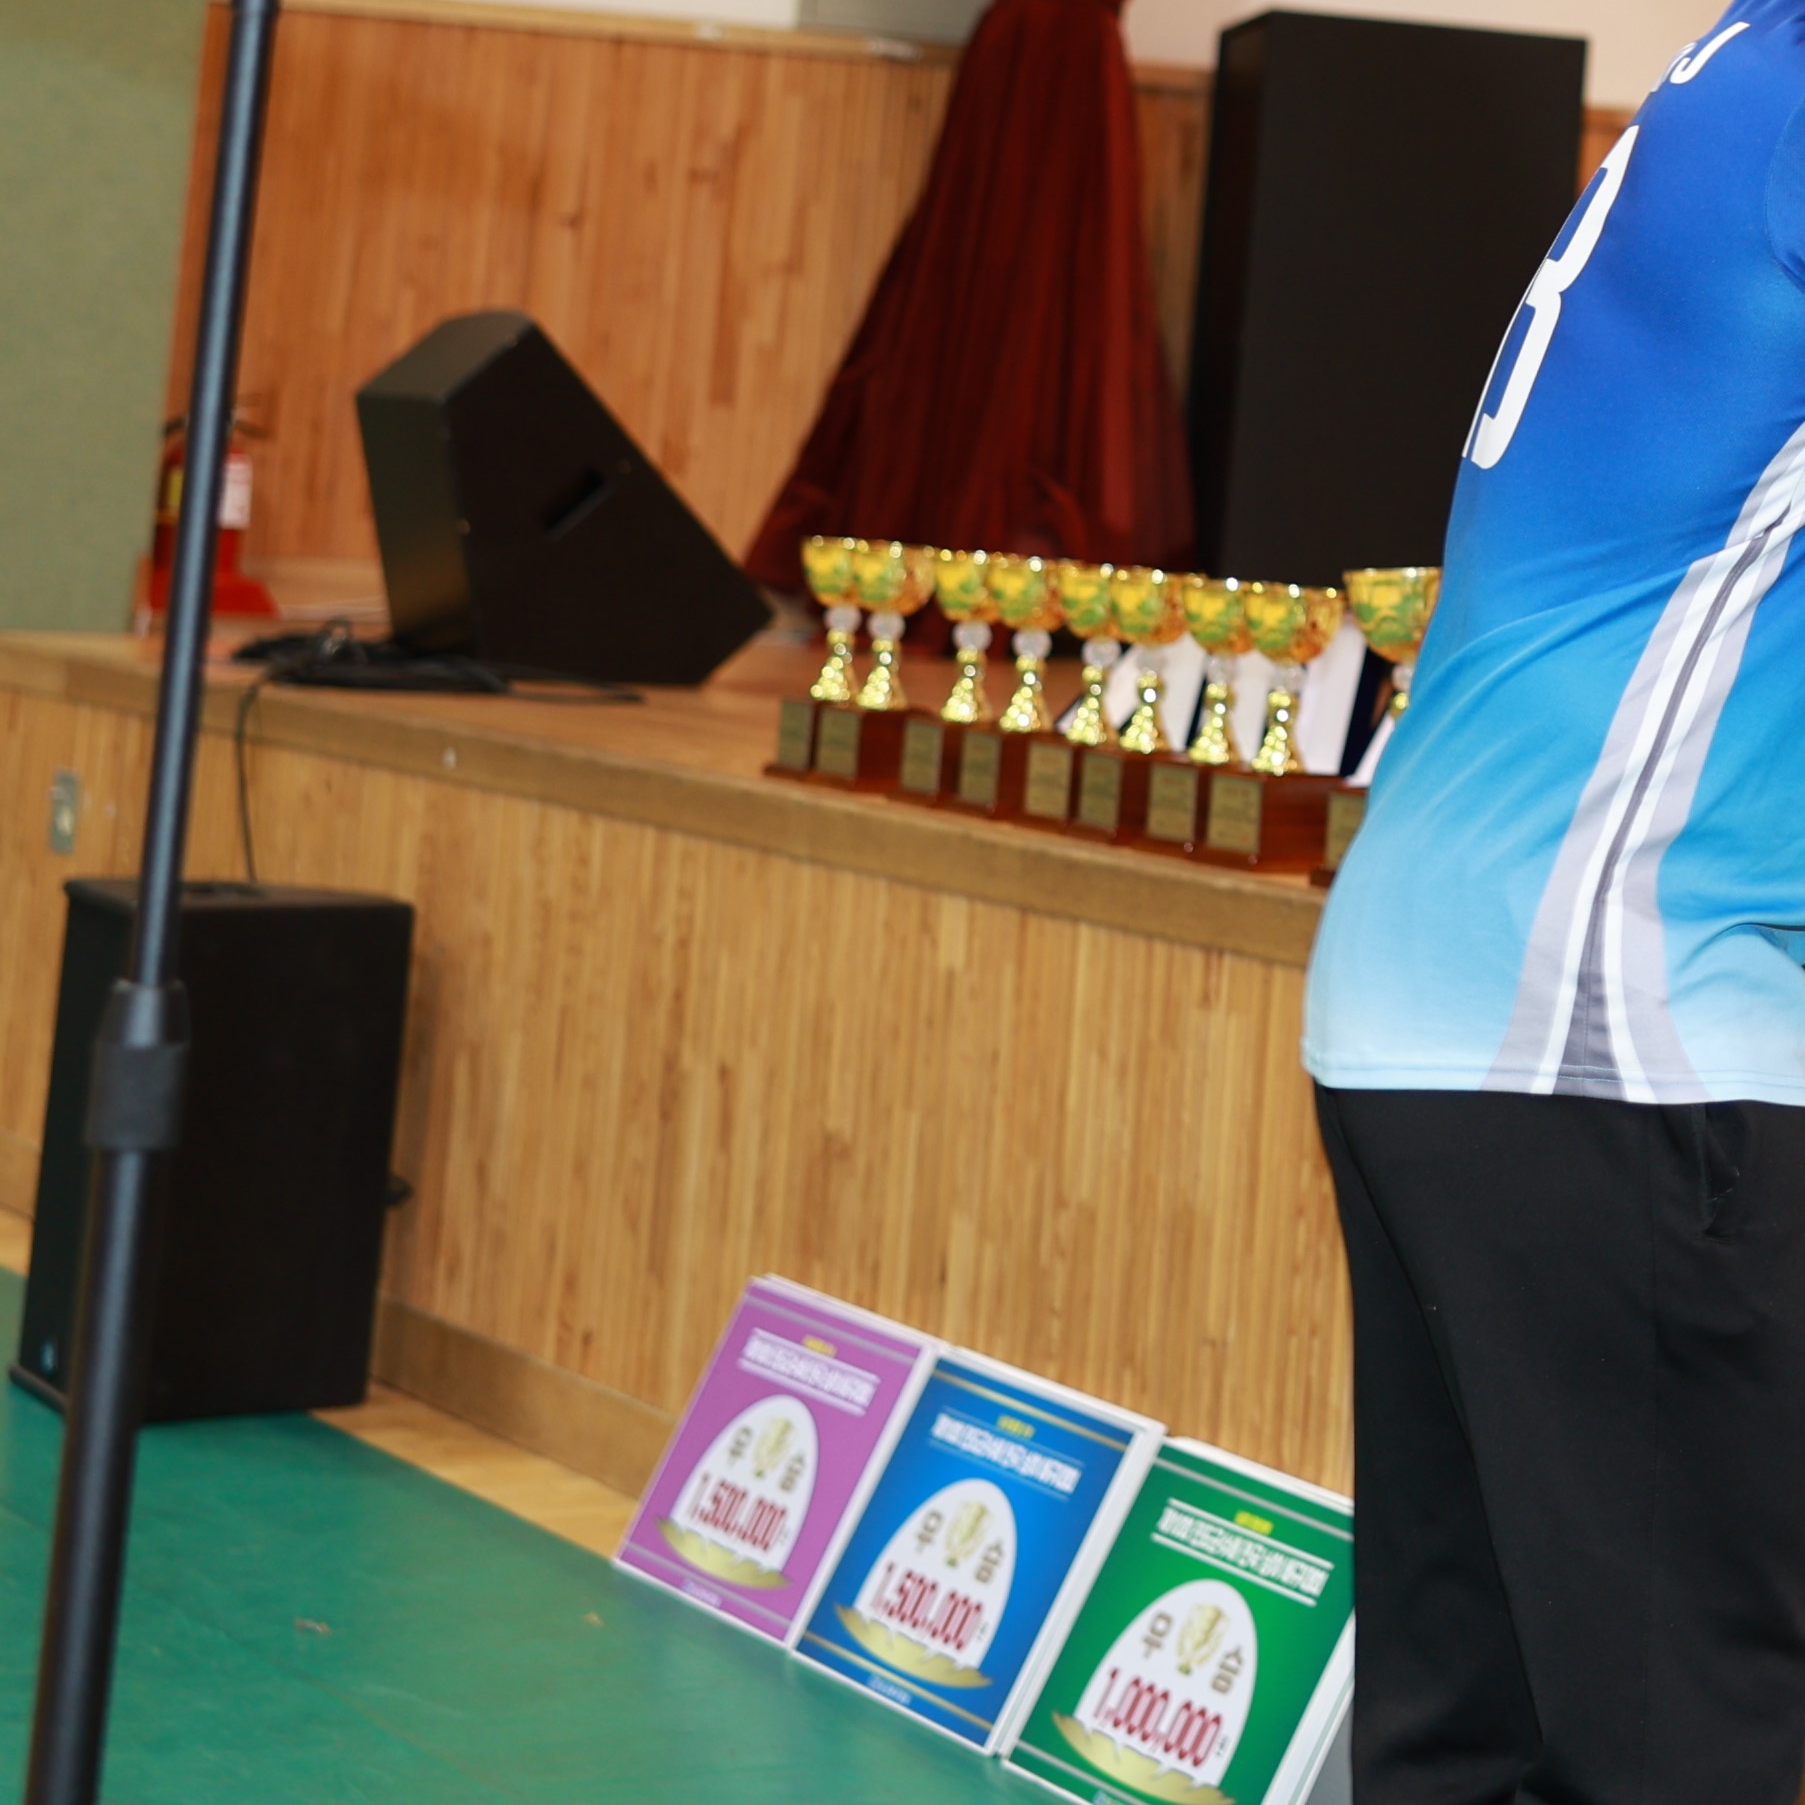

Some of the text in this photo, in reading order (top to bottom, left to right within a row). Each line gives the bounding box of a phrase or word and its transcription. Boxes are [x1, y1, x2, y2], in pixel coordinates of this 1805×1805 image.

[871, 1561, 984, 1652] 1,500,000
[1142, 1611, 1243, 1695] 우 승
[1093, 1667, 1222, 1768] 1,000,000
